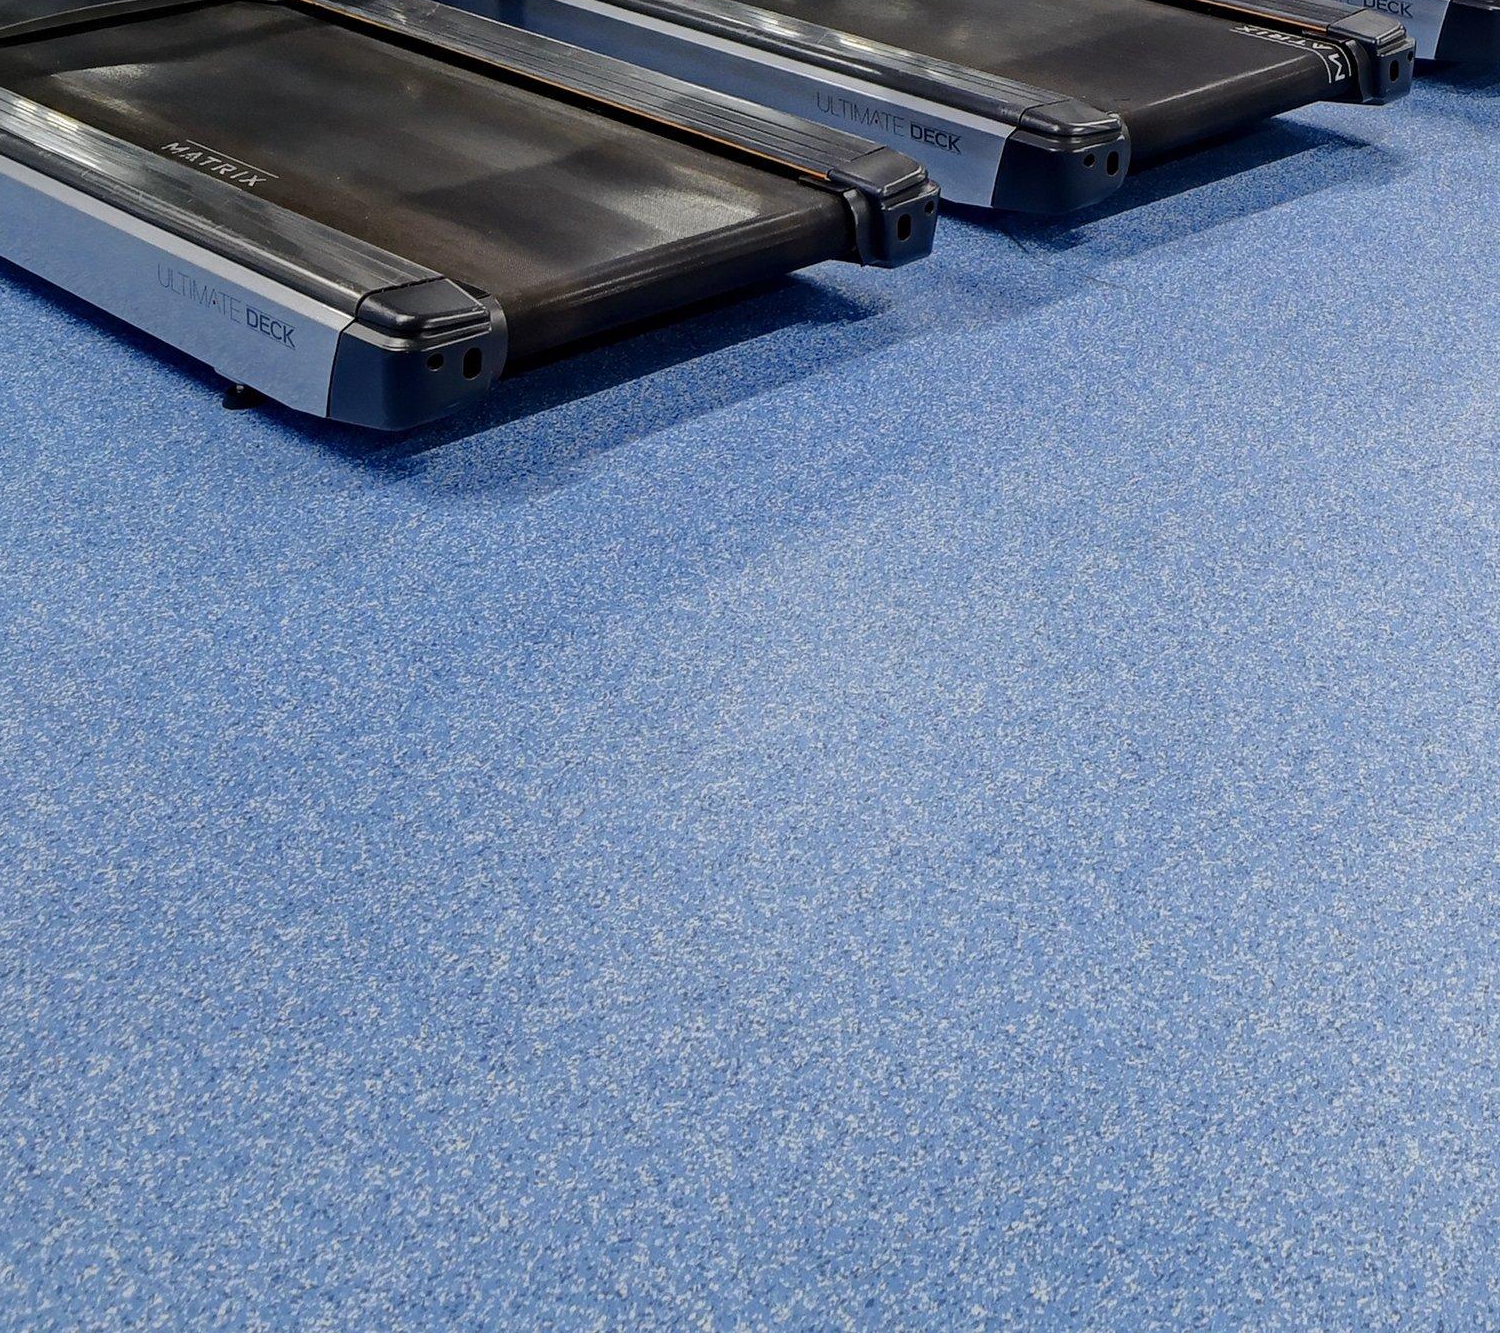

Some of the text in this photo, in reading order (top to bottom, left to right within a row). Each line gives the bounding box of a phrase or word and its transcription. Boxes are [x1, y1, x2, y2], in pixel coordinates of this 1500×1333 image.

[816, 90, 961, 155] ULTIMATE DECK
[161, 140, 267, 189] MATRIX
[157, 262, 296, 349] ULTIMATE DECK
